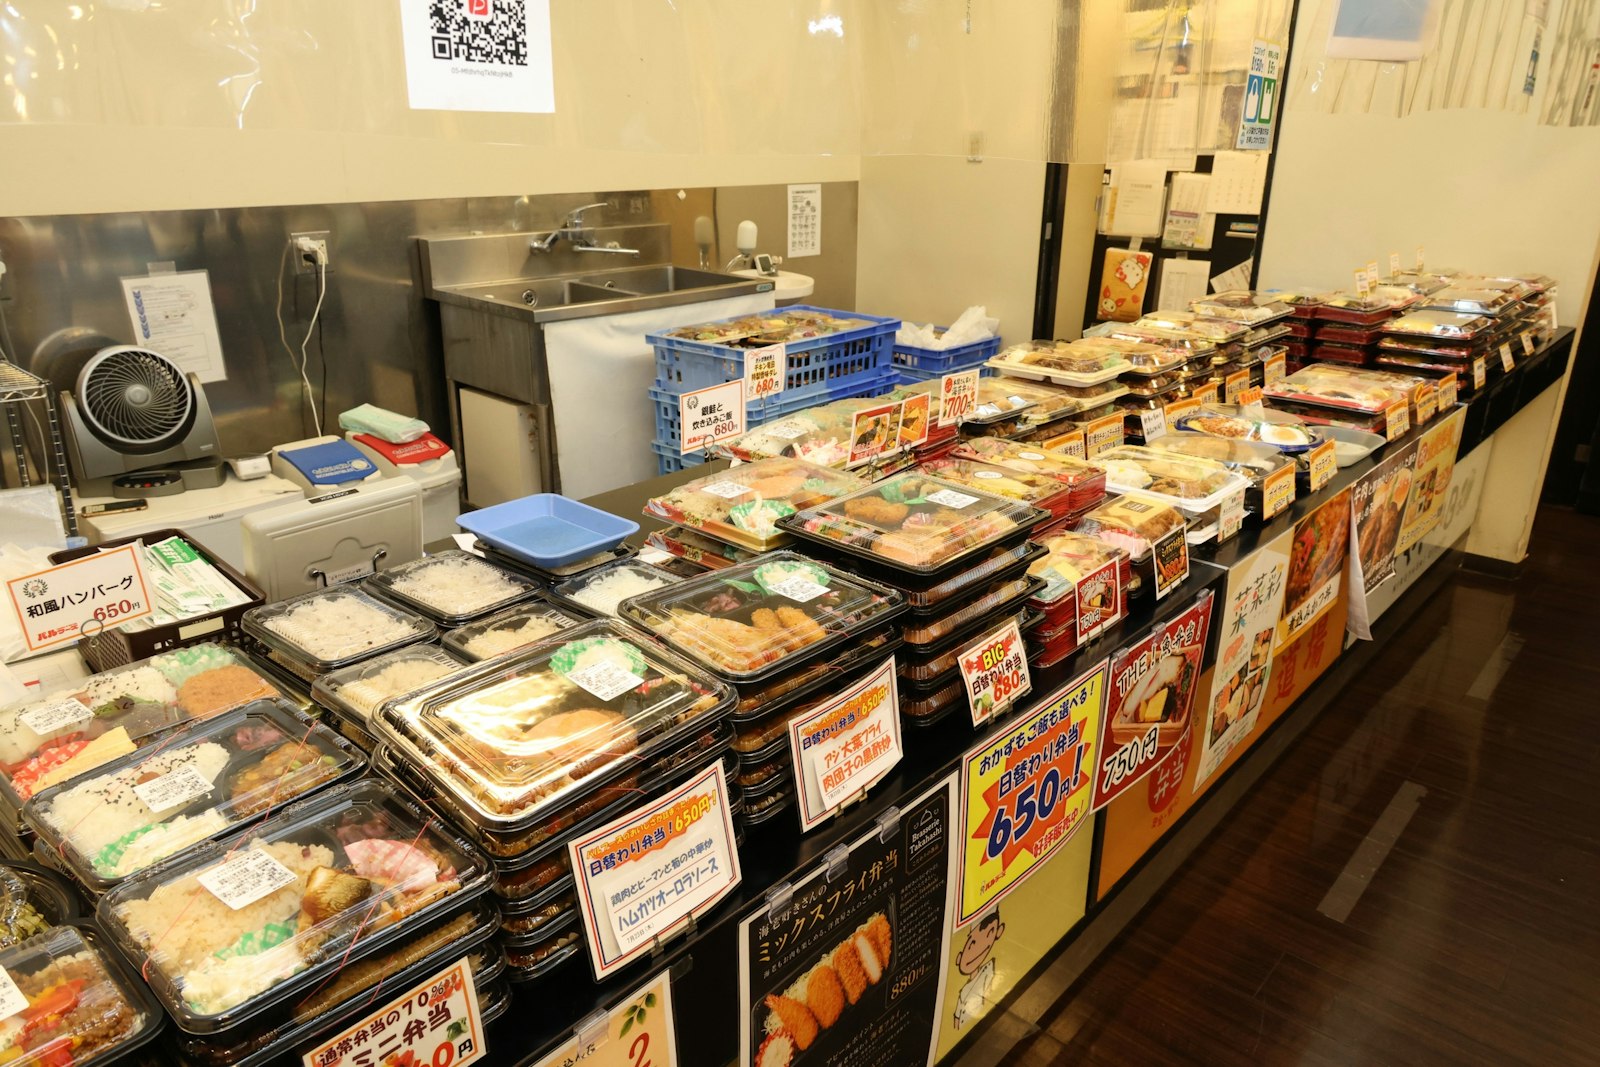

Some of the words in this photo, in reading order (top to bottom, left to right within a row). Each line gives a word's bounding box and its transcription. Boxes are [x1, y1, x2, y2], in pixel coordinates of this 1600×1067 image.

[755, 377, 780, 394] 680円
[691, 410, 733, 431] 炊き込みご飯
[714, 420, 738, 436] 680円
[26, 575, 134, 619] 和風ハンバーグ
[93, 600, 141, 622] 650円
[972, 652, 1022, 696] 日替わり弁当
[981, 643, 1005, 670] BIG
[993, 669, 1026, 702] 680円
[824, 719, 882, 769] アジ大葉フライ
[978, 680, 1096, 777] おかずもご飯も選べる!
[822, 734, 892, 793] 肉団子の黒酢炒
[998, 722, 1080, 799] 日替わり弁当
[1102, 723, 1160, 794] 750円
[909, 827, 943, 855] Takahashi
[911, 818, 941, 843] Brasserie
[1032, 799, 1085, 857] 好評販売中!
[618, 857, 719, 932] ハムカツオーロラソース
[758, 849, 899, 963] ミックスフライ弁当
[890, 967, 925, 1000] 880円
[352, 1001, 452, 1067] ミニ弁当
